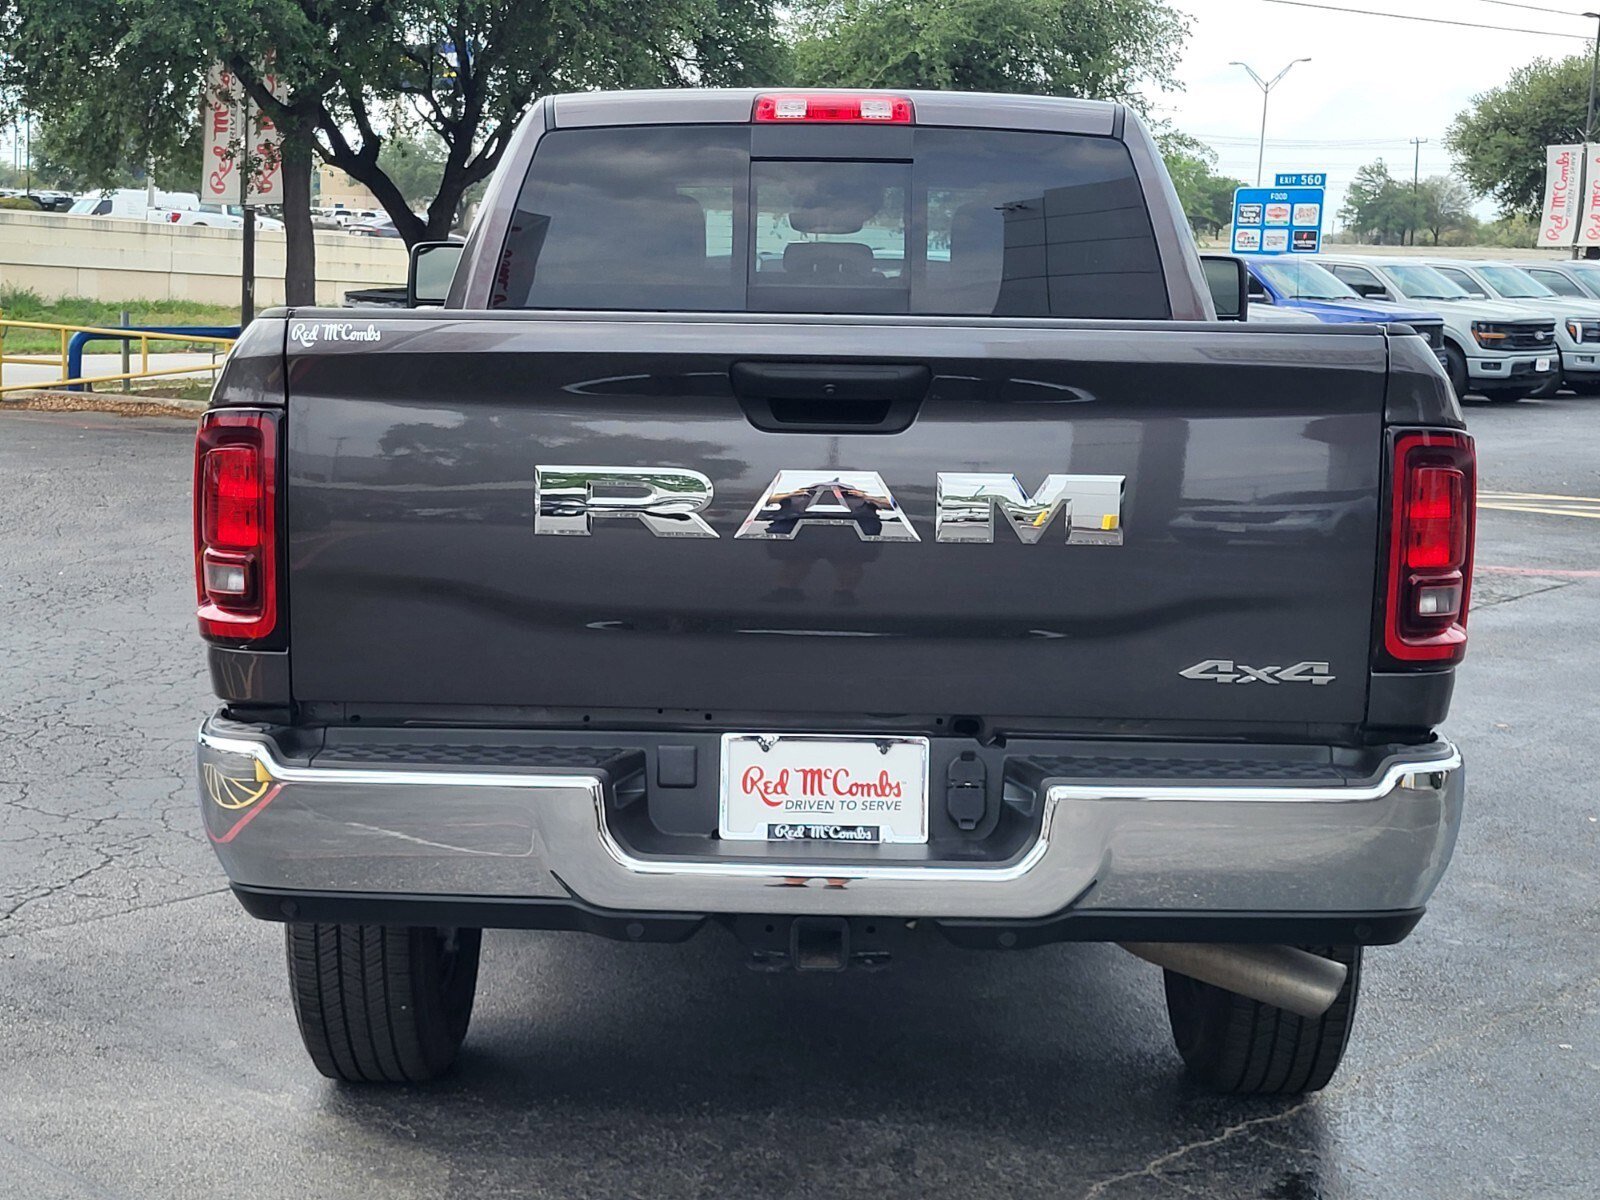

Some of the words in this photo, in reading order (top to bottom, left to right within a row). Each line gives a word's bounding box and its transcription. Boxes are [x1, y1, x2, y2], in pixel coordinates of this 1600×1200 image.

[209, 145, 234, 195] Red
[1279, 176, 1297, 185] EXIT
[1300, 174, 1322, 185] 560
[1550, 151, 1570, 212] McCombs
[1270, 192, 1288, 200] FOOD
[1545, 214, 1569, 241] Red
[291, 323, 319, 347] Red
[321, 323, 381, 341] McCombs
[533, 464, 1127, 547] RAM
[1178, 659, 1336, 685] 4x4
[742, 765, 789, 807] Red
[794, 767, 902, 798] McCombs
[785, 800, 835, 811] DRIVEN
[839, 800, 857, 811] TO
[861, 800, 902, 811] SERVE
[774, 824, 804, 840] Red
[806, 824, 872, 840] McCombs
